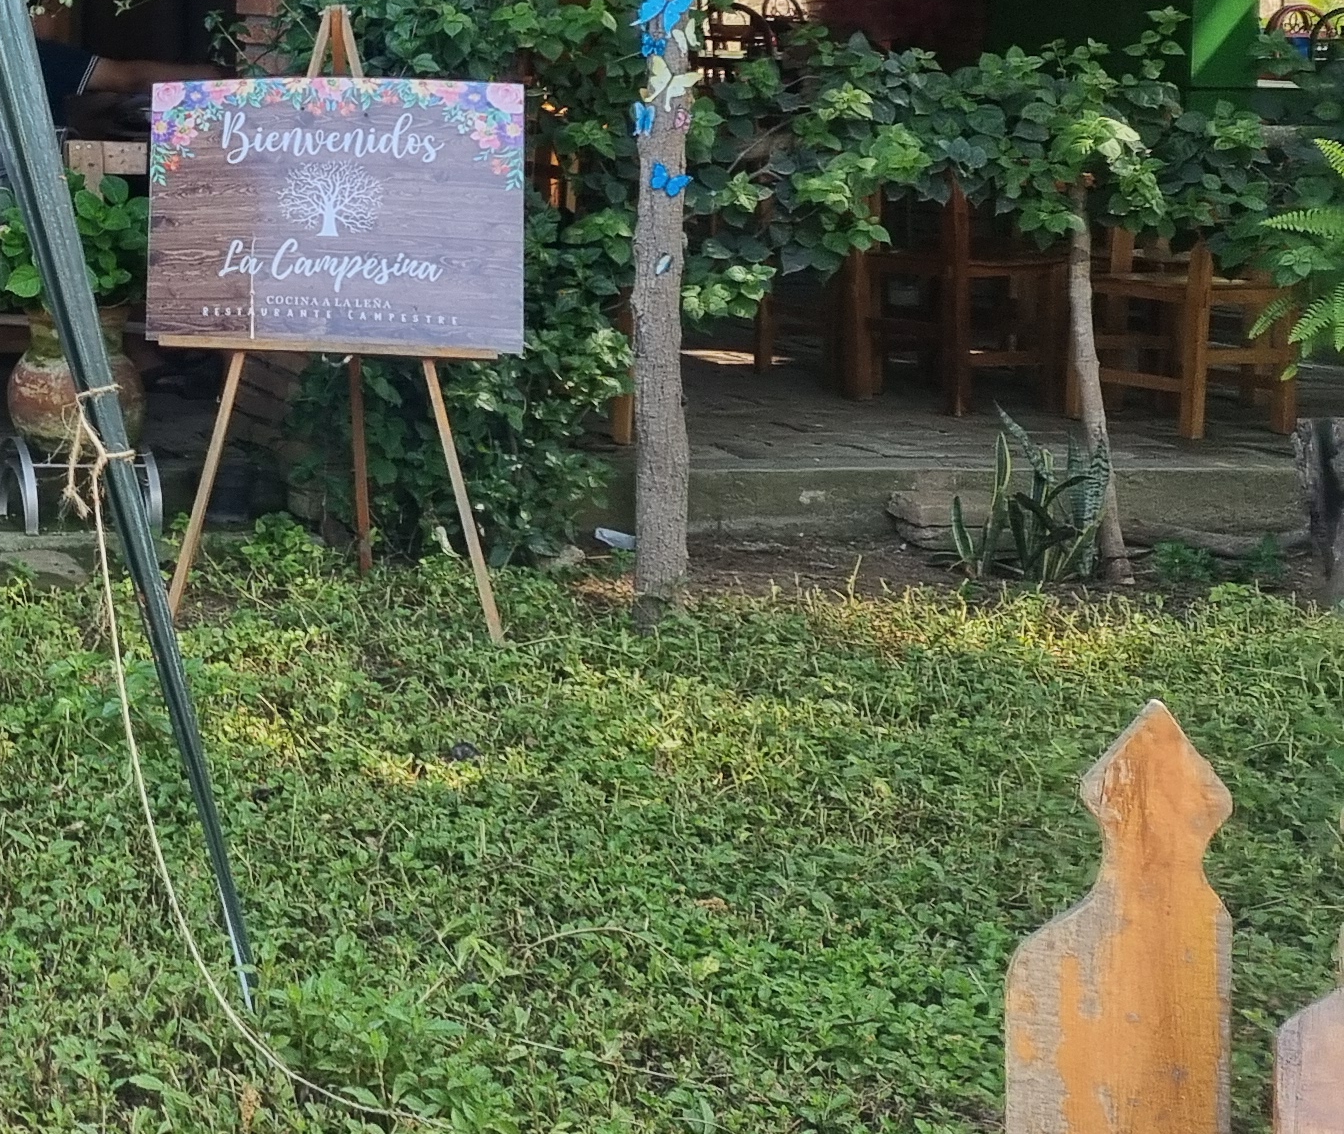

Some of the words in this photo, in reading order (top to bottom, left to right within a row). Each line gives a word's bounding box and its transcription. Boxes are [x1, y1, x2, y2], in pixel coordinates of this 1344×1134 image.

[221, 110, 445, 164] Bienvenidos
[218, 239, 263, 277] La
[271, 238, 443, 293] Campesina
[202, 306, 332, 319] RESTAURANTE
[347, 310, 458, 325] CAMPESTRE
[266, 295, 319, 307] COCINA
[321, 297, 331, 308] A
[334, 297, 351, 309] LA
[355, 296, 391, 310] LEÑA
